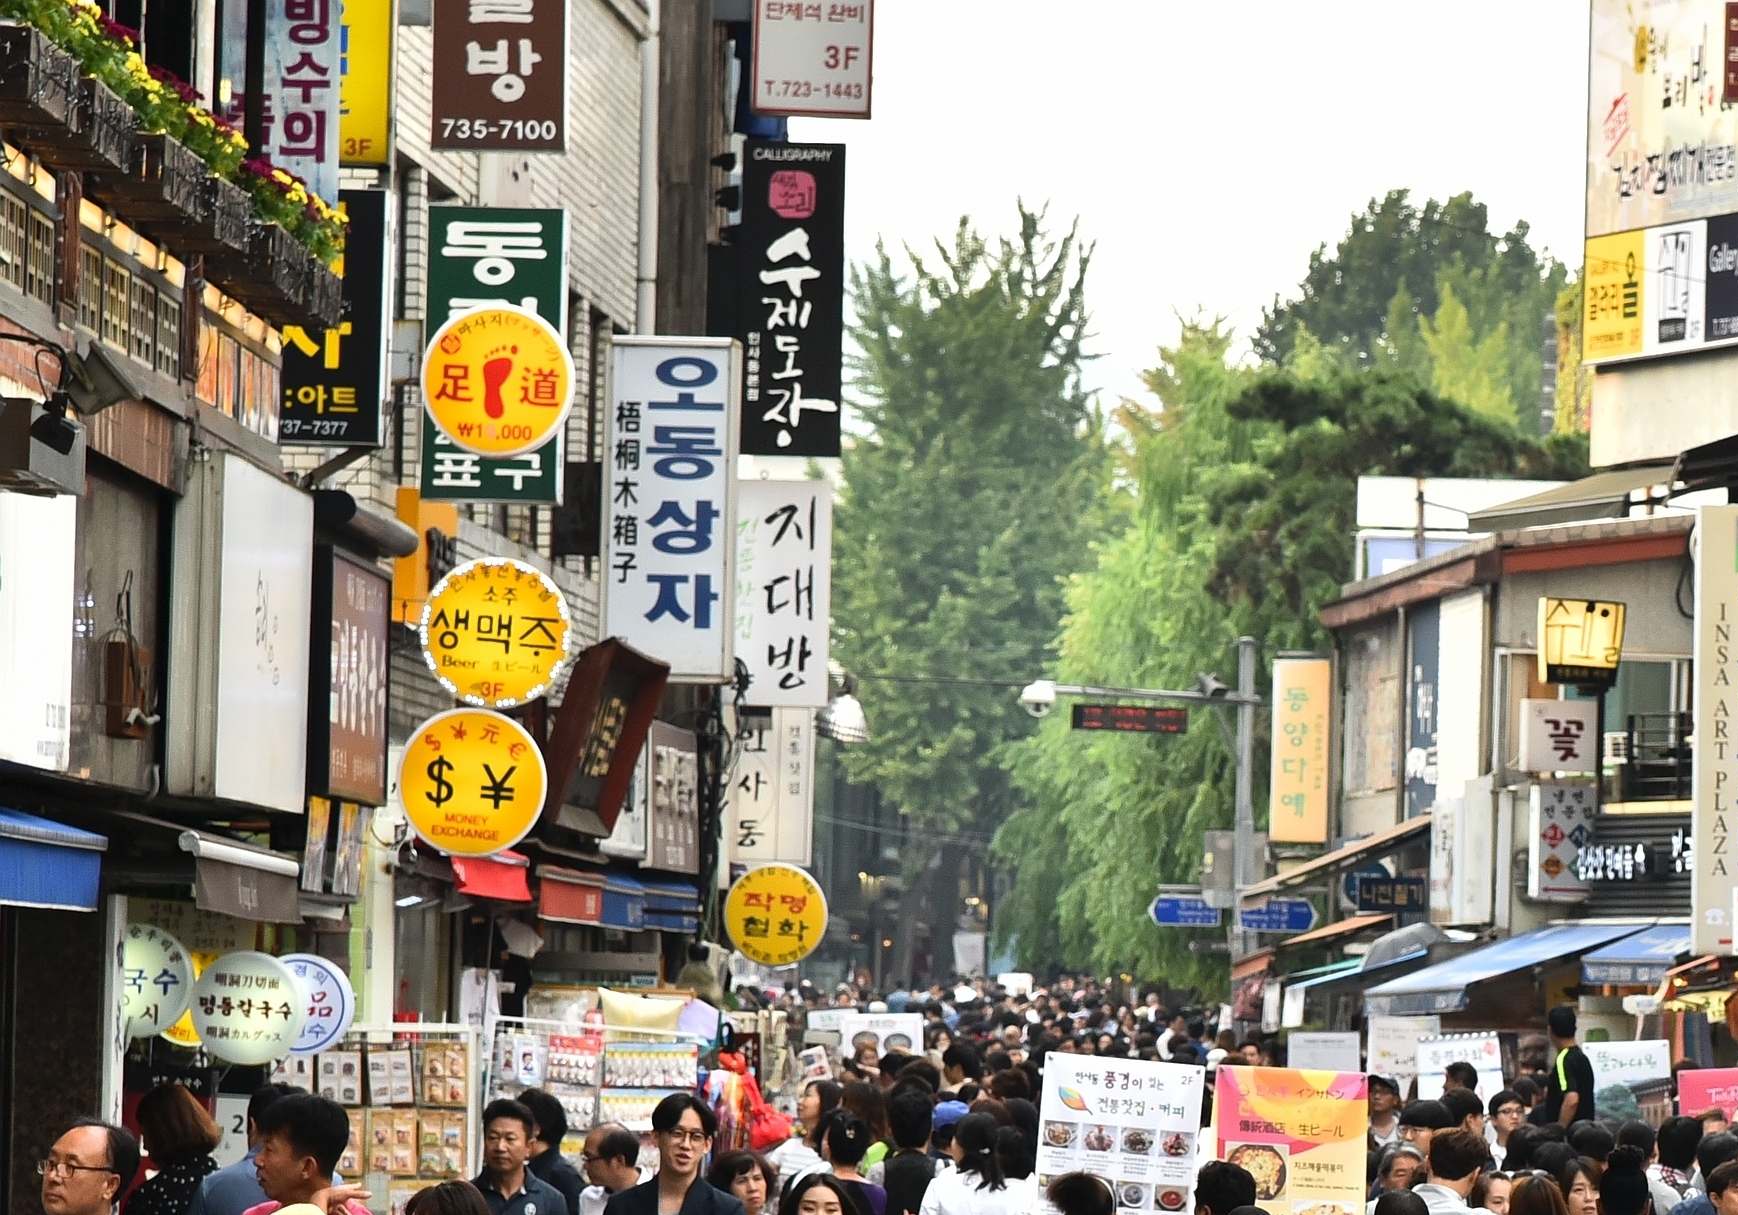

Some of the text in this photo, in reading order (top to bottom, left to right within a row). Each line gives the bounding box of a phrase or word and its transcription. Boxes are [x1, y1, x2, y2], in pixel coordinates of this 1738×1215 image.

[765, 2, 822, 22] 단체석
[825, 46, 860, 71] 3F
[764, 79, 864, 99] T.723-1443
[441, 118, 557, 141] 735-7100
[344, 139, 371, 156] 3F
[753, 148, 833, 161] CALLIGRAPHY
[758, 227, 838, 448] 수제도장
[435, 364, 561, 407] 足 道
[432, 452, 543, 491] 표구
[613, 401, 642, 584] 梧桐木箱子
[644, 356, 724, 630] 오동상자
[763, 496, 816, 690] 지대방
[432, 608, 560, 656] 생맥주
[441, 654, 479, 670] Beer
[481, 681, 505, 698] 3F
[1544, 719, 1584, 762] 꽃
[1712, 602, 1731, 876] INSA ART PLAZA
[444, 812, 489, 826] MONEY
[431, 825, 500, 843] EXCHANGE
[199, 995, 293, 1022] 명동칼국수
[1104, 1071, 1143, 1090] 풍경이
[1181, 1076, 1194, 1086] 2F
[1098, 1097, 1185, 1119] 전통찻집 커피
